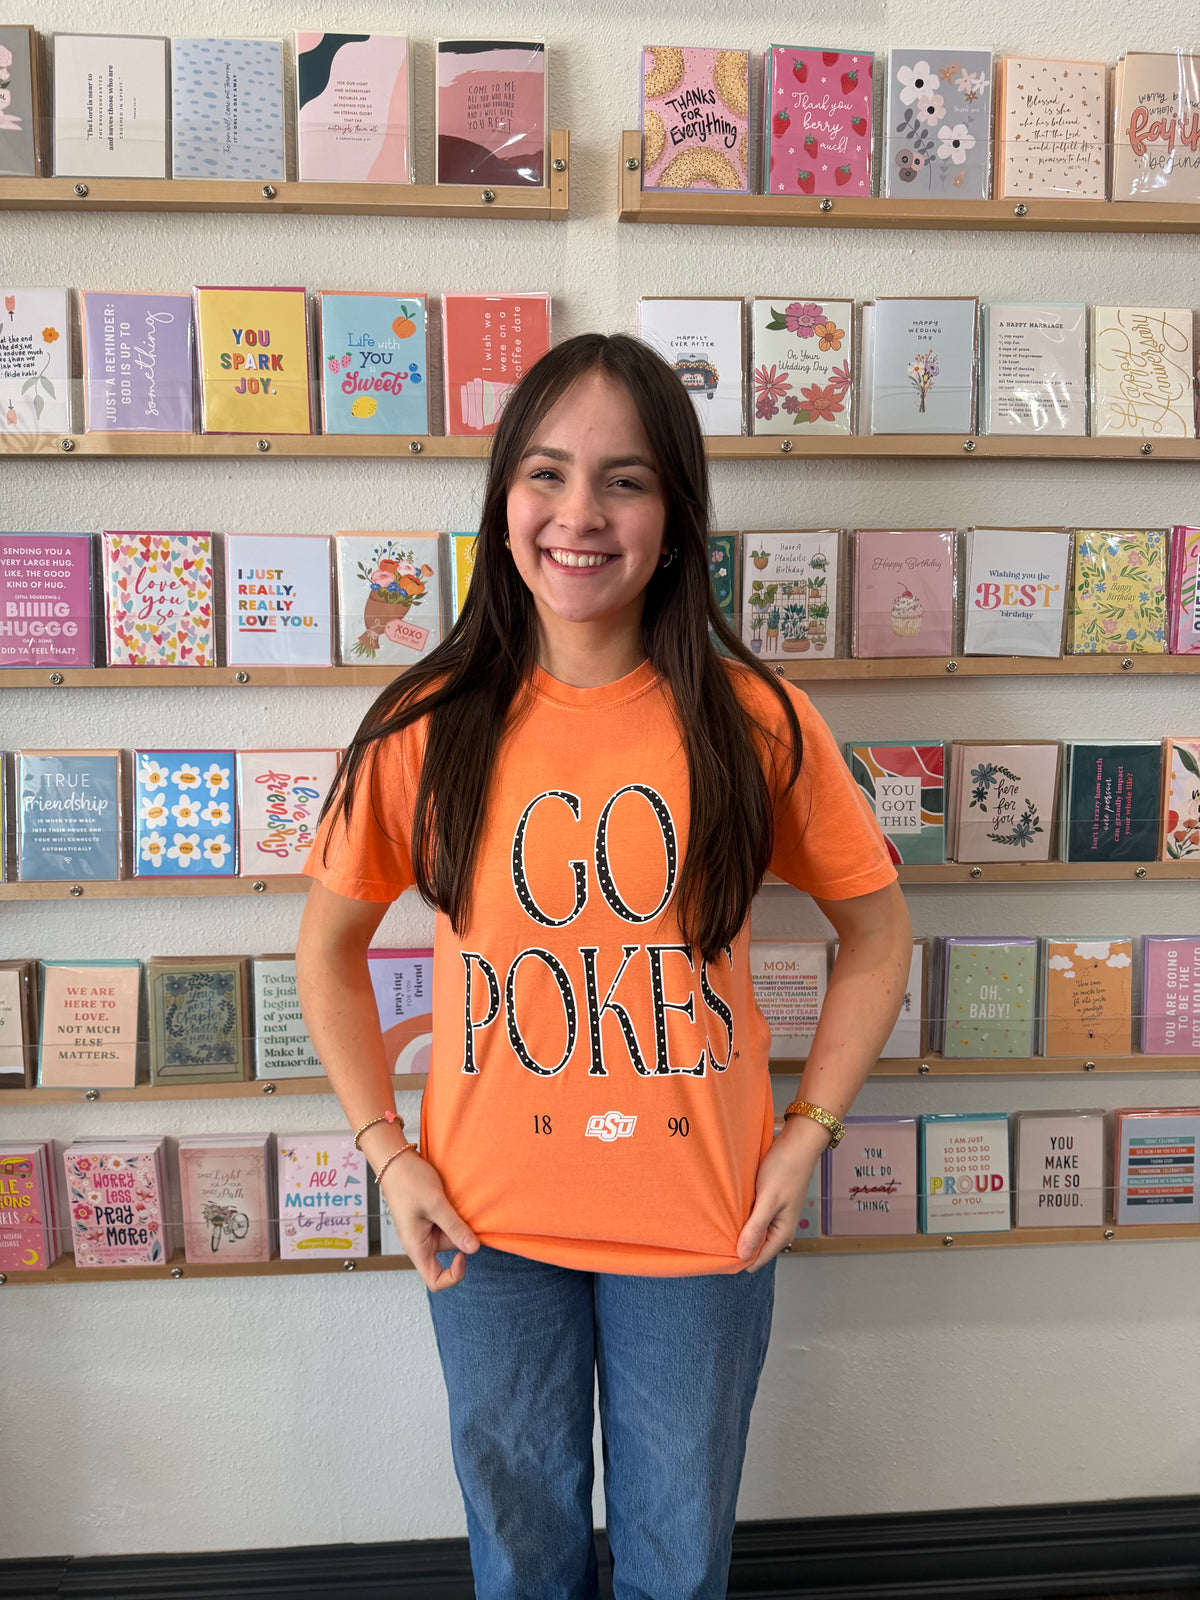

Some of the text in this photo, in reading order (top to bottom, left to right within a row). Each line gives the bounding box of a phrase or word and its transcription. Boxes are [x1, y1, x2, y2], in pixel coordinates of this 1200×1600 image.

[665, 87, 716, 114] THANKS
[791, 91, 853, 117] Thank you
[680, 107, 703, 124] FOR
[670, 111, 737, 148] Everything
[803, 112, 843, 140] berry
[485, 312, 491, 328] we
[232, 328, 271, 347] YOU
[500, 324, 506, 338] on
[347, 332, 400, 349] Life with
[482, 334, 491, 360] wish
[512, 306, 522, 378] coffee date
[104, 303, 117, 423] JUST A REMINDER:
[120, 322, 131, 405] GOD IS UP TO
[134, 310, 174, 417] something
[221, 353, 284, 371] SPARK
[779, 360, 829, 375] Wedding Day
[235, 377, 277, 395] JOY.
[341, 370, 408, 396] Sweet
[872, 557, 943, 572] Happy Birthday
[4, 570, 23, 578] LIKE,
[135, 566, 182, 595] love
[238, 569, 284, 580] I JUST
[989, 570, 1020, 580] Wishing
[1037, 572, 1050, 581] the
[238, 584, 297, 597] REALLY,
[975, 583, 1060, 610] BEST
[6, 602, 70, 617] BIIIIIG
[138, 592, 184, 620] you
[238, 601, 294, 611] REALLY
[156, 608, 179, 626] so
[238, 616, 318, 627] LOVE YOU.
[1000, 610, 1034, 619] birthday
[0, 621, 78, 636] HUGGG
[395, 624, 422, 639] XOXO
[44, 773, 90, 788] TRUE
[1116, 766, 1124, 794] impact
[881, 784, 916, 796] YOU
[995, 779, 1019, 797] here
[24, 792, 108, 816] Friendship
[881, 800, 916, 812] GOT
[995, 797, 1016, 813] for
[1094, 801, 1102, 821] crazy
[1115, 796, 1123, 826] grandly
[254, 770, 297, 858] friendship
[881, 816, 917, 826] THIS
[992, 813, 1015, 830] you
[511, 783, 678, 928] GO
[763, 961, 800, 971] MOM:
[263, 974, 297, 984] Today
[414, 964, 423, 998] friend
[67, 987, 87, 996] WE
[394, 972, 404, 1015] praying
[1165, 950, 1178, 1045] YOU ARE GOING
[1178, 966, 1189, 1030] TO BE THE
[64, 1000, 117, 1009] HERE TO
[460, 944, 733, 1078] POKES
[970, 1003, 1010, 1018] BABY!
[74, 1013, 110, 1022] LOVE.
[176, 1010, 223, 1025] Chapter
[57, 1025, 120, 1034] NOT MUCH
[264, 1024, 287, 1032] next
[74, 1038, 103, 1047] ELSE
[264, 1035, 309, 1045] chapter
[58, 1050, 120, 1060] MATTERS.
[265, 1047, 304, 1057] Make it
[533, 1111, 689, 1142] 18 OSU 90
[1050, 1136, 1074, 1150] YOU
[316, 1151, 329, 1166] It
[864, 1148, 882, 1159] YOU
[1045, 1155, 1078, 1170] MAKE
[309, 1168, 337, 1188] All
[854, 1165, 892, 1177] WILL DO
[930, 1174, 1003, 1195] PROUD
[1042, 1174, 1080, 1188] ME SO
[850, 1178, 902, 1200] great
[284, 1193, 362, 1208] Matters
[857, 1200, 889, 1213] THINGS
[1038, 1194, 1083, 1207] PROUD.
[297, 1211, 350, 1231] to Jesus
